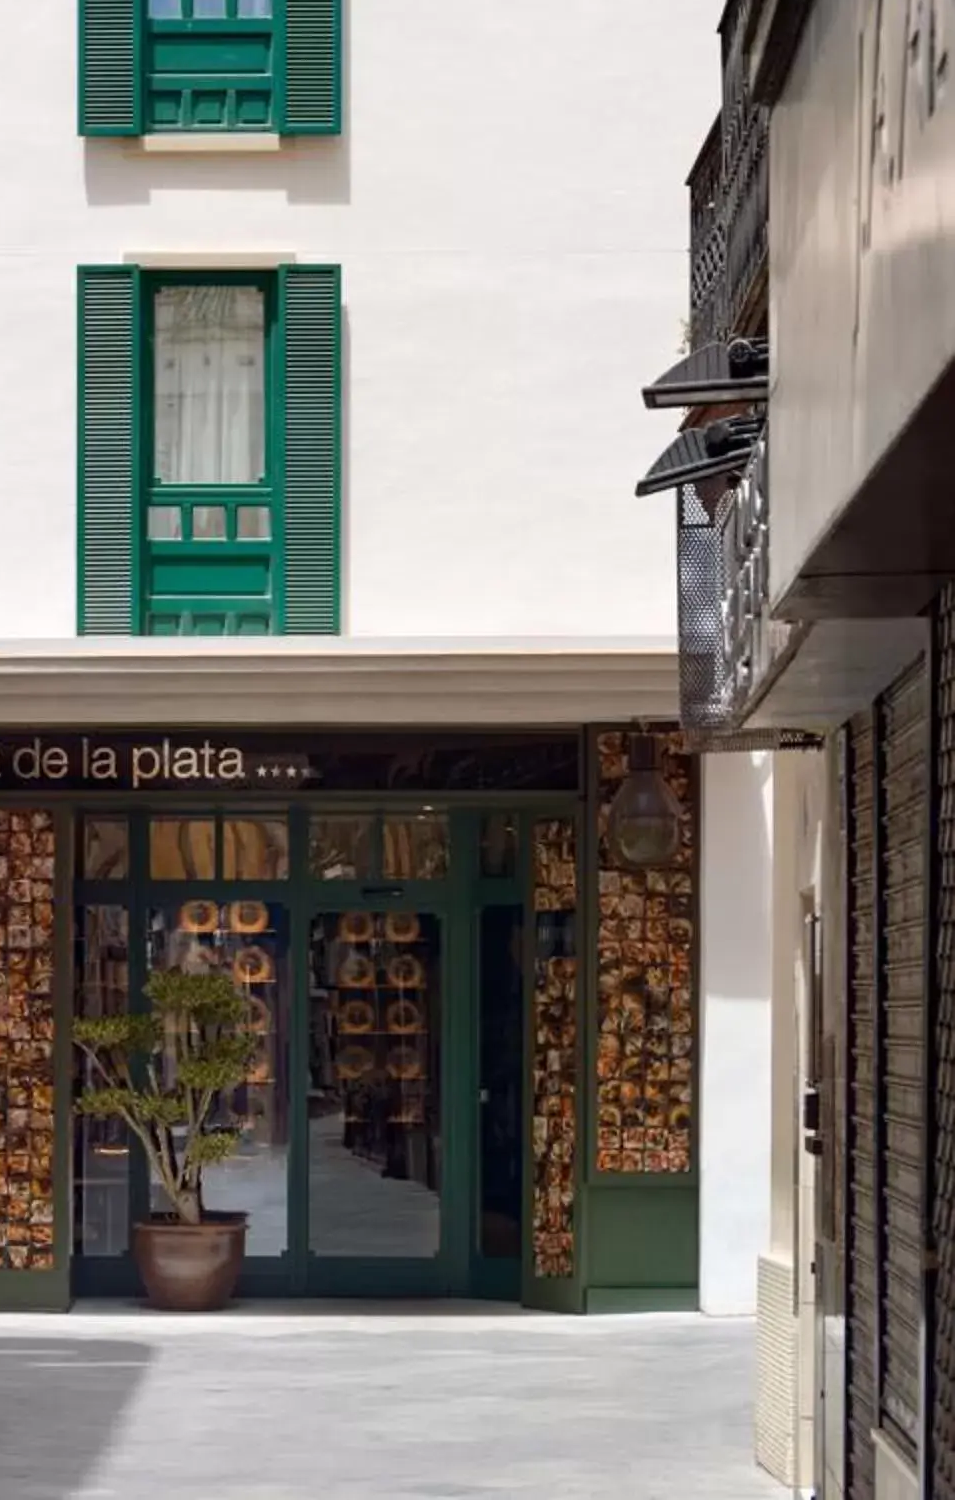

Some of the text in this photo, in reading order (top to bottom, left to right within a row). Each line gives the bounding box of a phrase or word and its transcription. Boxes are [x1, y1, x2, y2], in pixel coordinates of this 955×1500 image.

[13, 738, 69, 779] de
[82, 737, 118, 779] la
[132, 738, 245, 788] plata
